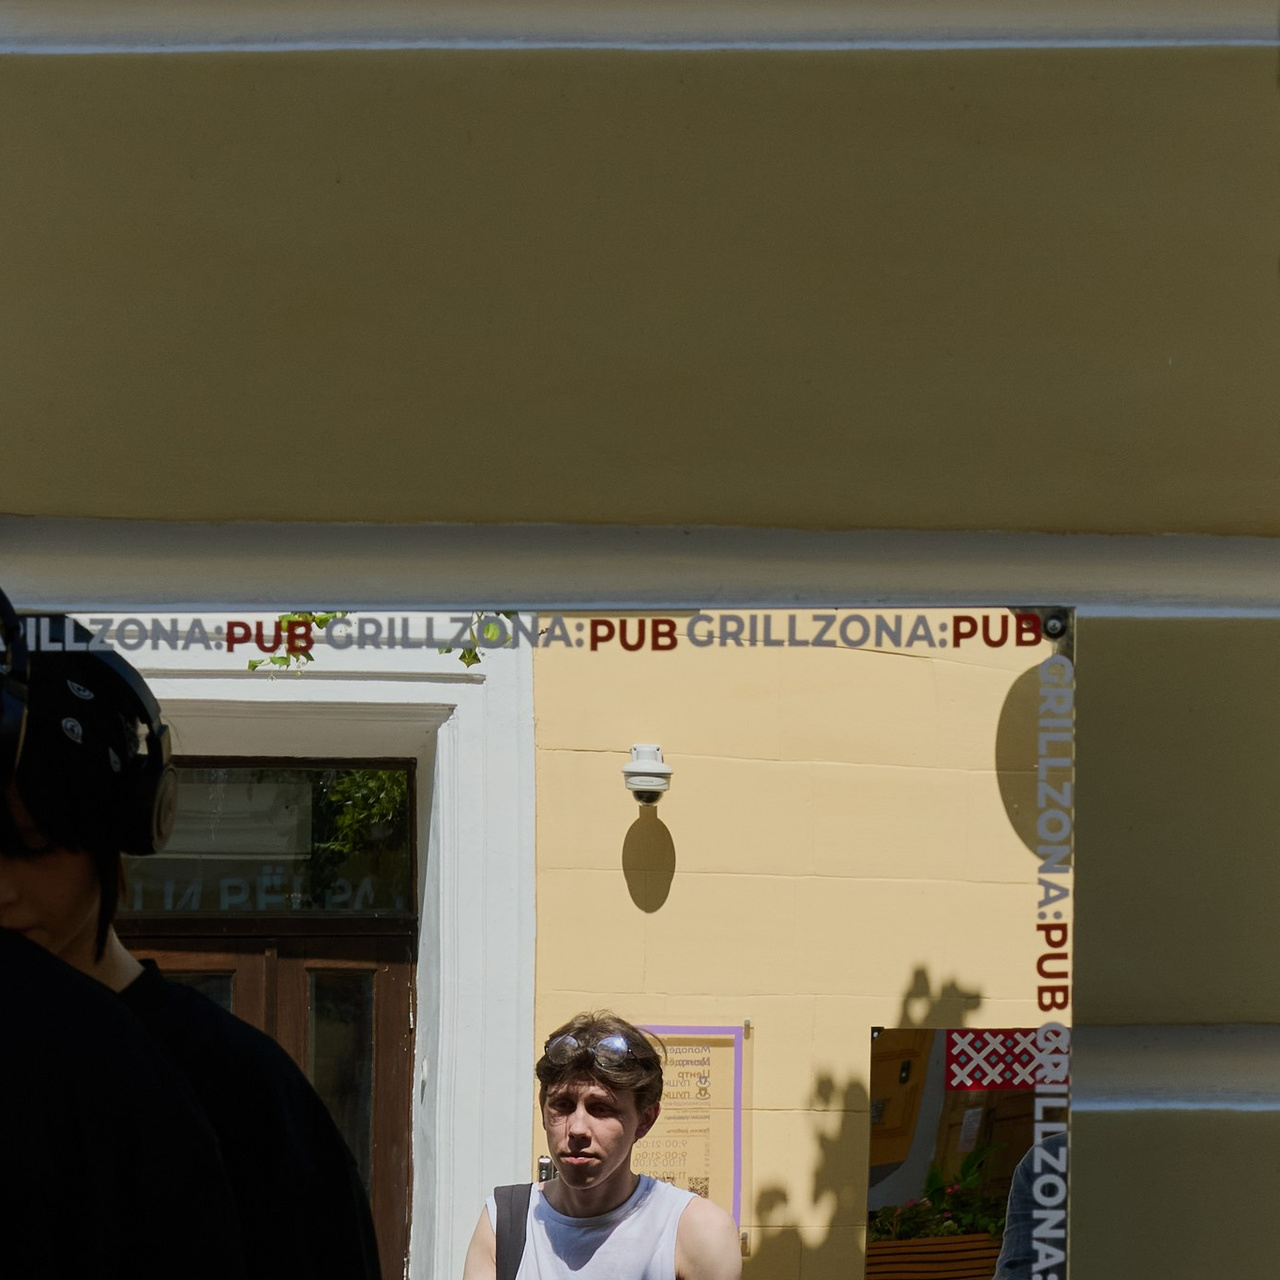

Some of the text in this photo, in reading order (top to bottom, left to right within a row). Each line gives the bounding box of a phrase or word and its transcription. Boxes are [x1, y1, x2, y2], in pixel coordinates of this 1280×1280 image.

[325, 613, 678, 652] GRILLZONA:PUB
[686, 612, 1045, 649] GRILLZONA:PUB
[1036, 653, 1075, 1012] GRILLZONA:PUB
